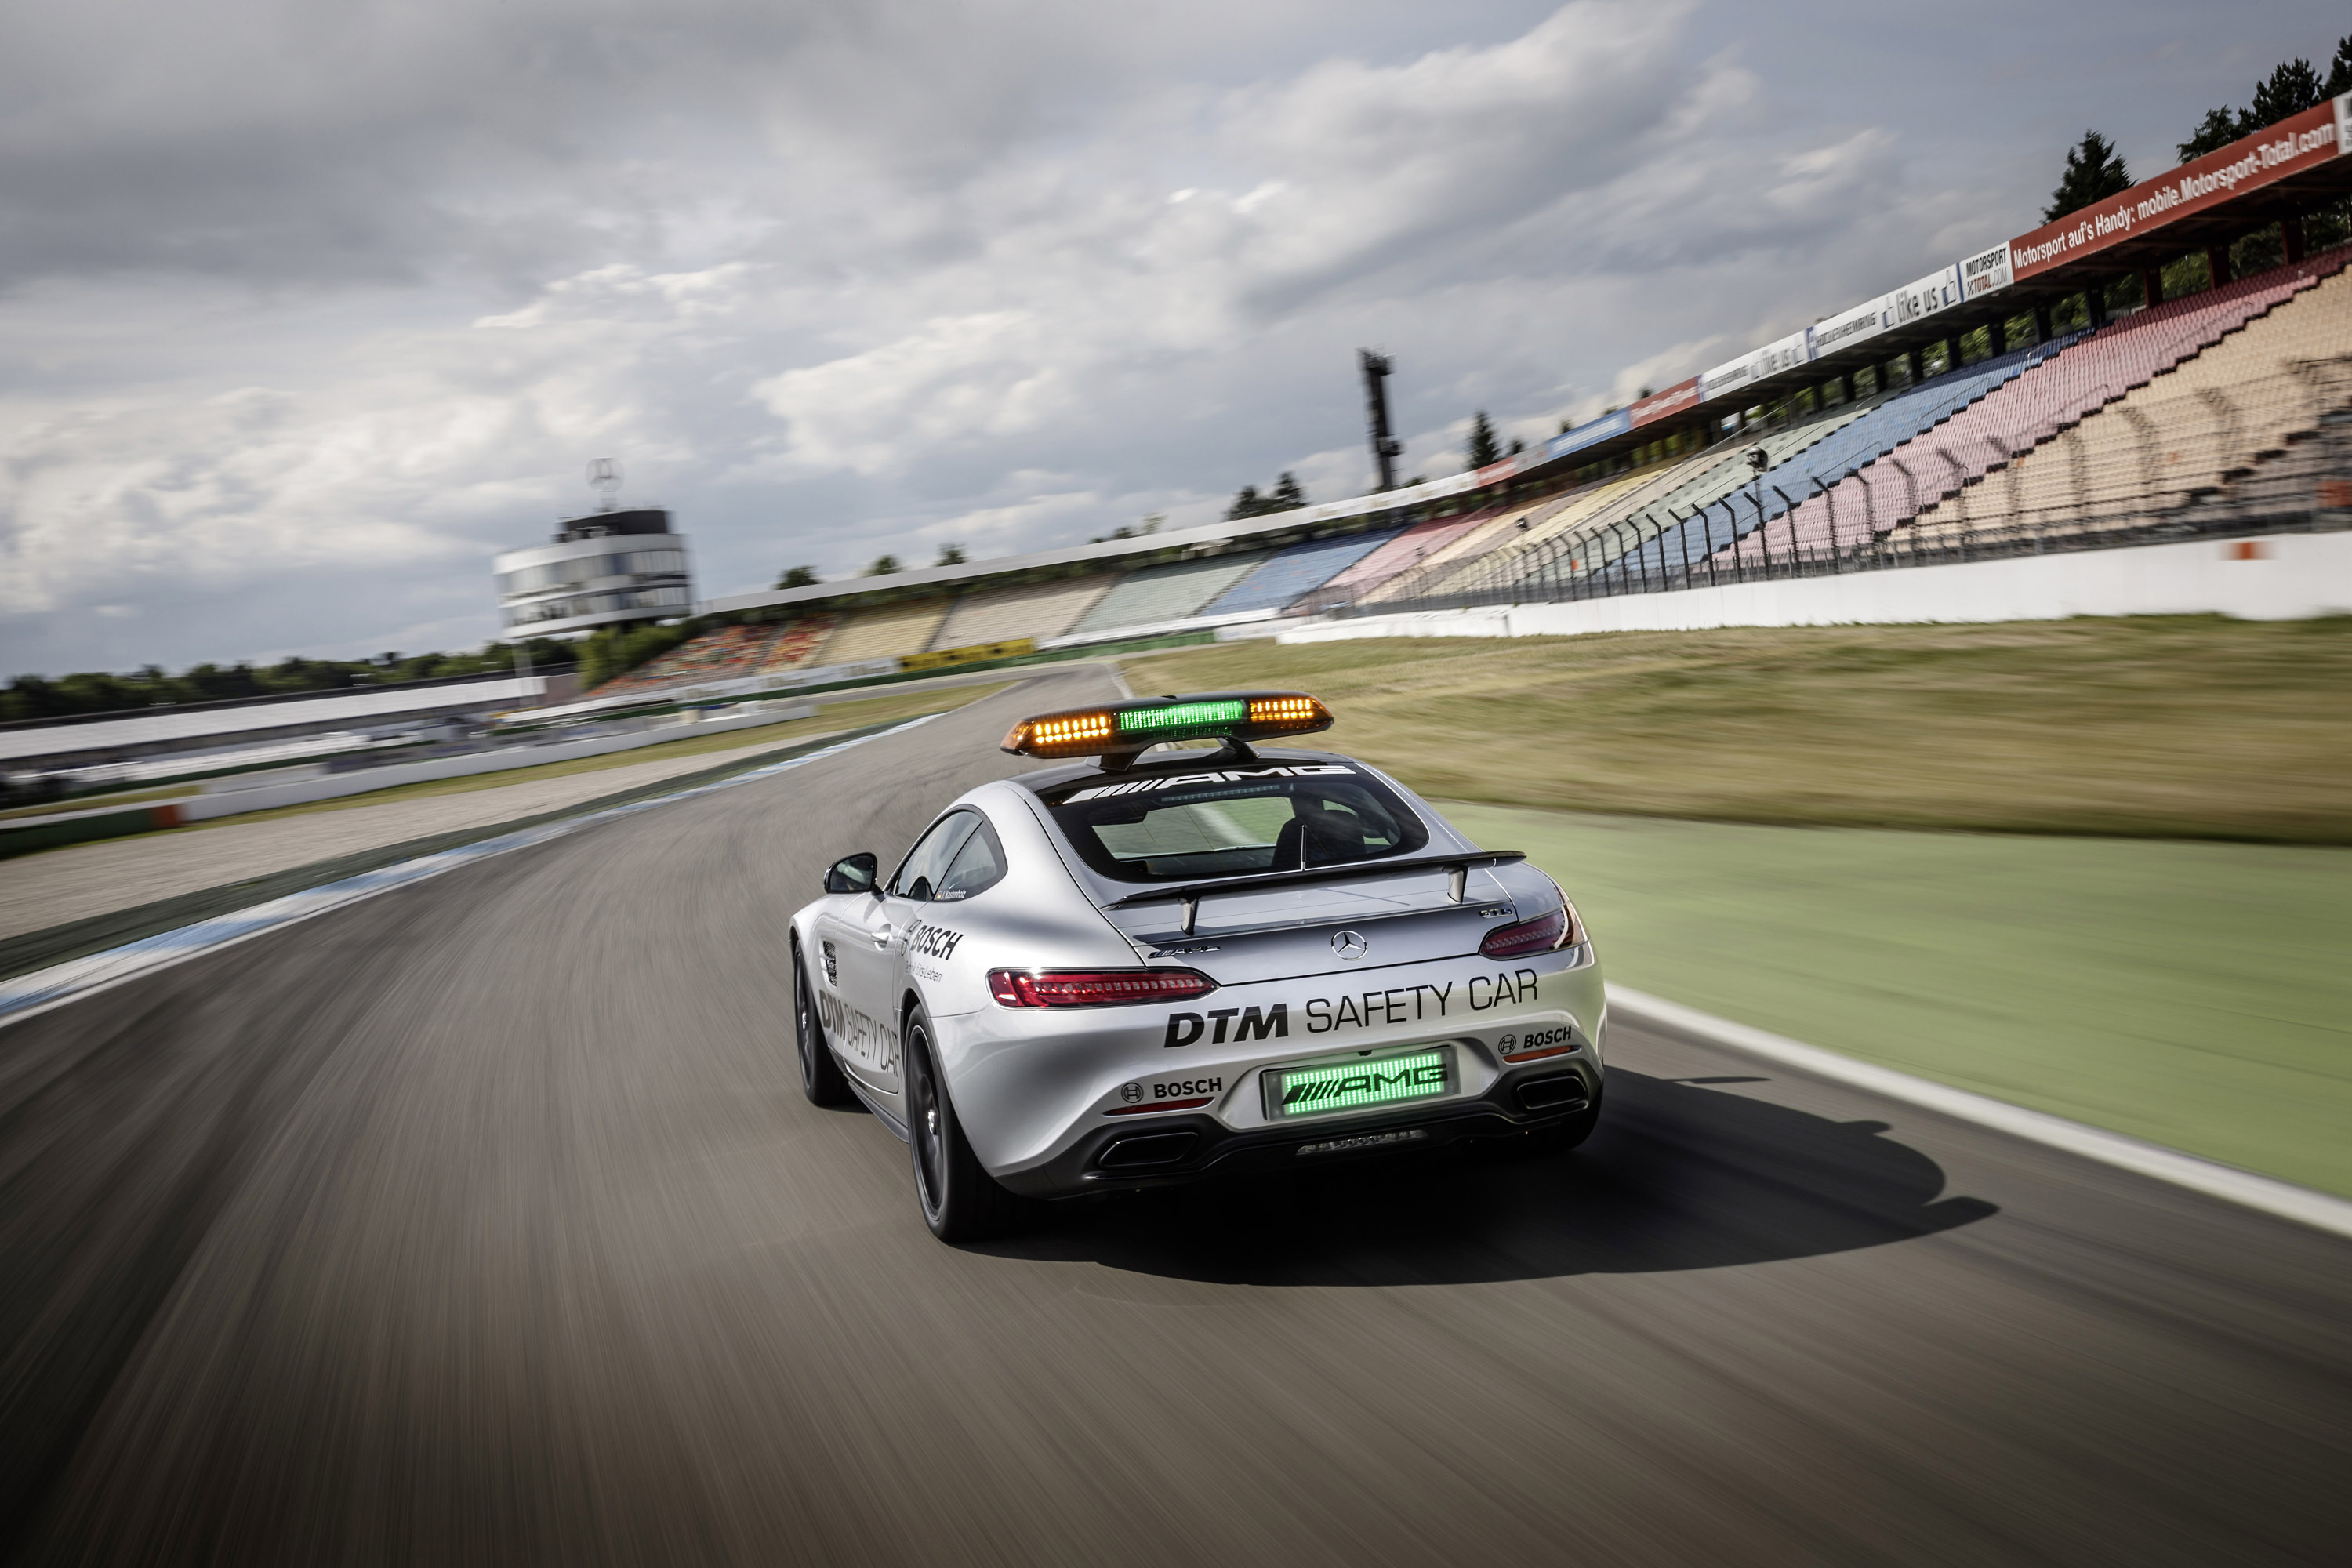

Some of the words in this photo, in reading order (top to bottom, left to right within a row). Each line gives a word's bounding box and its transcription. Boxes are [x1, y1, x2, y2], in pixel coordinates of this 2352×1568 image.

[2013, 234, 2067, 270] Motorsport
[2095, 206, 2136, 237] Handy:
[1966, 246, 2007, 278] MOTORSPORT
[1896, 289, 1920, 324] like
[1923, 286, 1938, 313] us
[910, 925, 964, 960] BOSCH
[1163, 1004, 1289, 1048] DTM
[1306, 982, 1453, 1033] SAFETY
[1468, 968, 1537, 1011] CAR
[819, 989, 846, 1041] DTM
[844, 1003, 877, 1064] SAFETY
[1523, 1026, 1572, 1049] BOSCH
[1153, 1076, 1222, 1099] BOSCH
